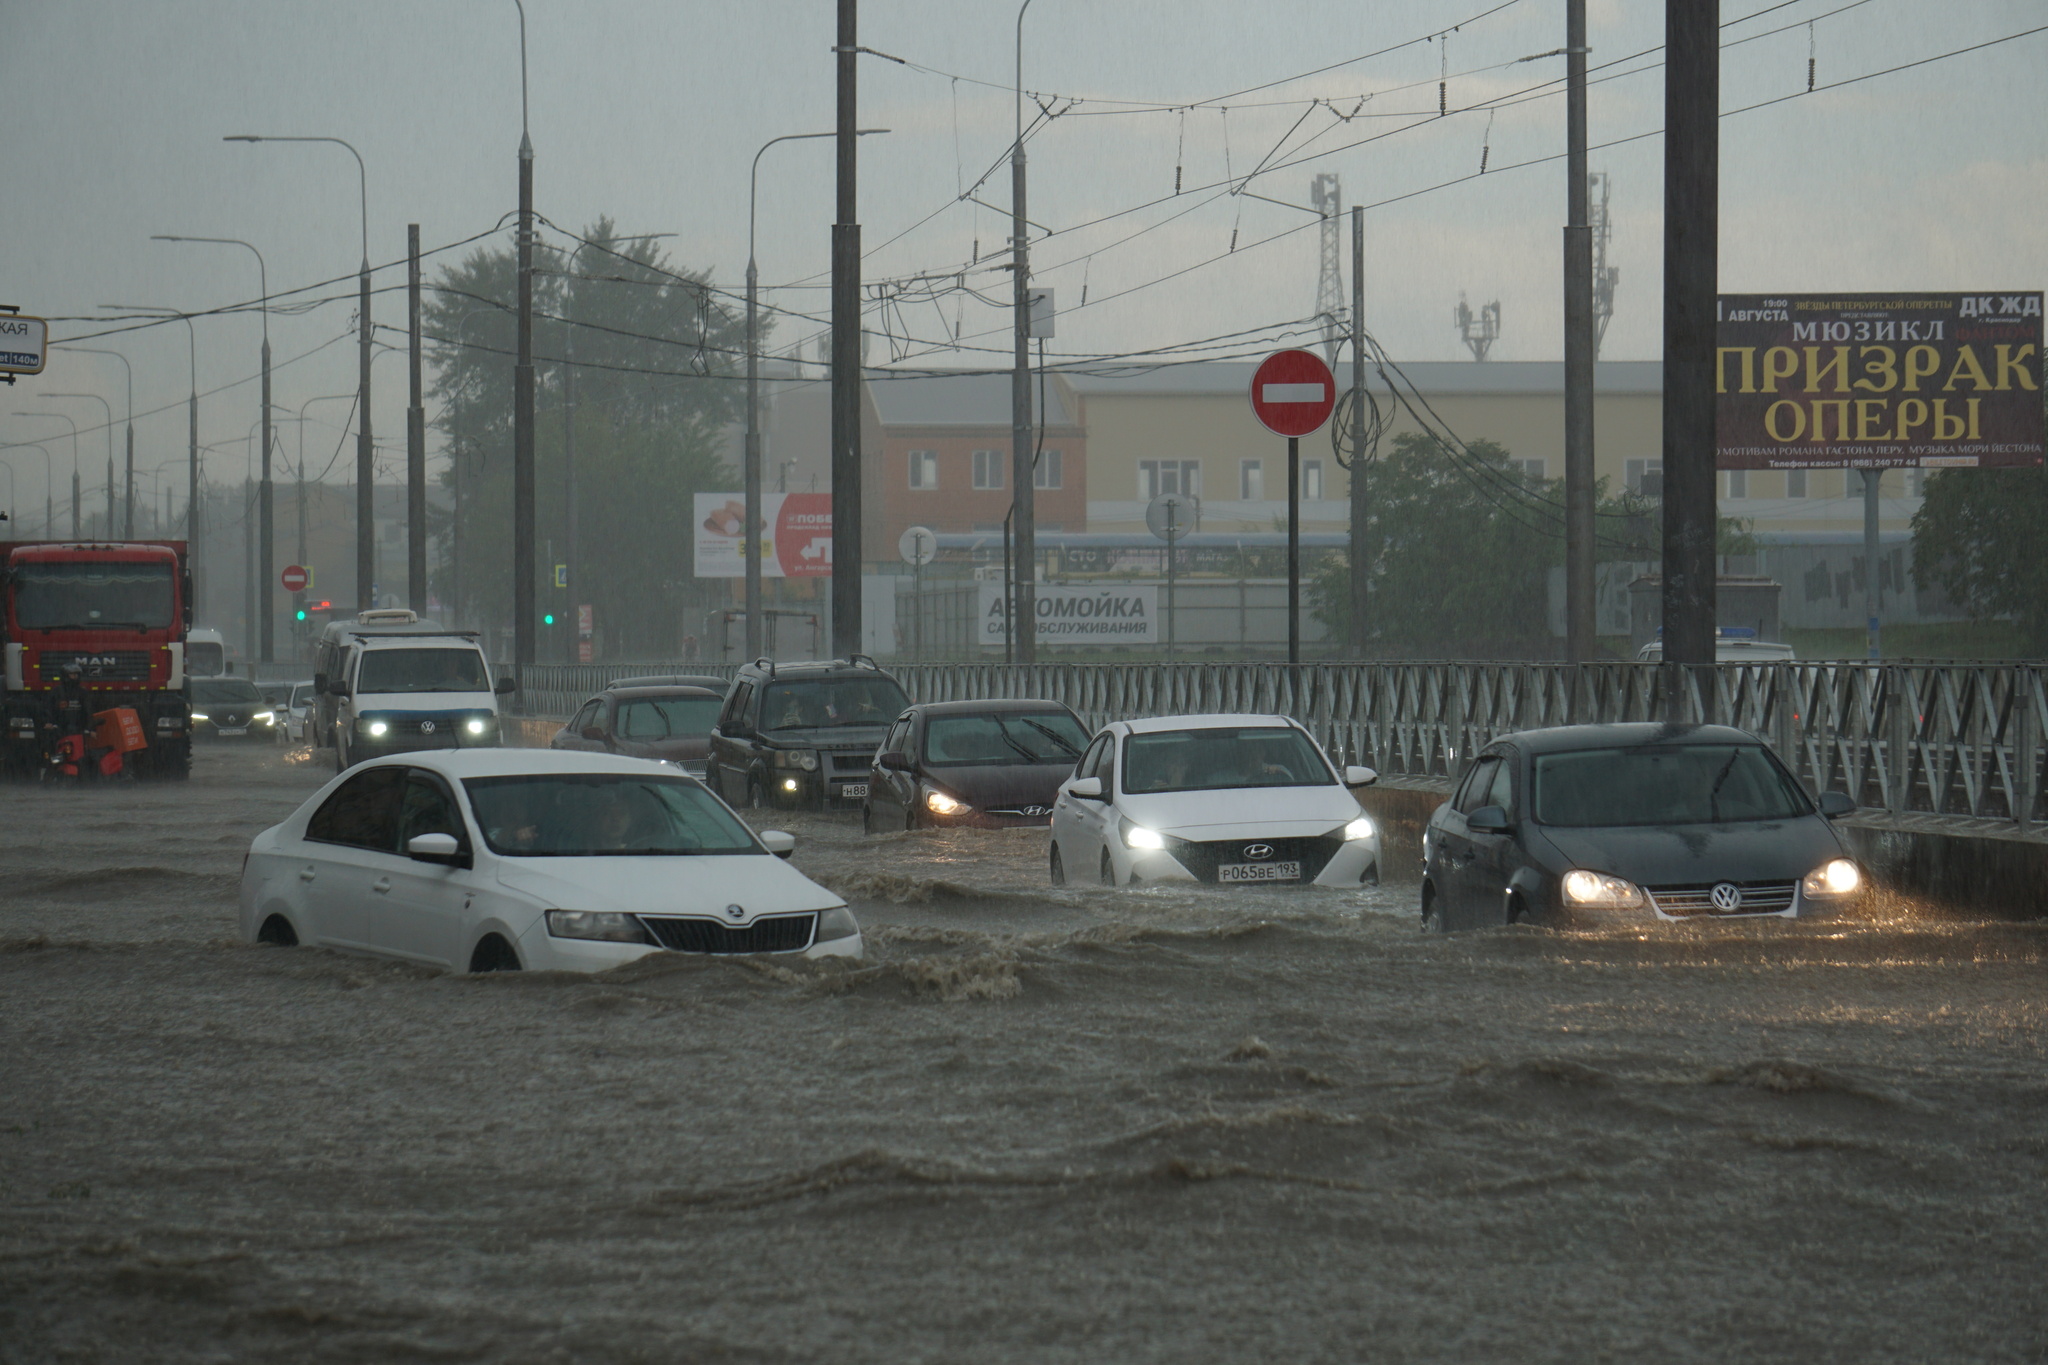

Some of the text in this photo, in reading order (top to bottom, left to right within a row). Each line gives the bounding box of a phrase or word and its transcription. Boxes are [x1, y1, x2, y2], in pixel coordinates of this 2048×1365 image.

[1763, 298, 1788, 308] 19:00
[1832, 299, 1904, 311] ПЕТЕРБУРГСКОЙ
[1906, 299, 1953, 310] ОПЕРЕТТЫ
[1959, 295, 2041, 318] ДК ЖД
[1729, 309, 1789, 321] АВГУСТА
[1792, 320, 1944, 342] МЮЗИКЛ
[1716, 344, 2039, 394] ПРИЗРАК
[1764, 398, 1982, 442] ОПЕРЫ
[1722, 442, 2042, 456] МОТИВАМ РОМАНА ГАСТОНА ЛЕРУ. МУЗЫКА МОРИ ЙЕСТОНА
[1769, 459, 1807, 469] Телефон
[1810, 460, 1841, 468] кассы:
[1843, 459, 1849, 467] 8
[1875, 458, 1891, 467] 240
[1893, 458, 1904, 466] 77
[1905, 458, 1917, 466] 44
[1069, 550, 1097, 562] СТО
[988, 592, 1144, 617] АОМОЙКА
[75, 657, 116, 665] MAN
[846, 785, 869, 796] Н88
[1277, 863, 1297, 874] 193
